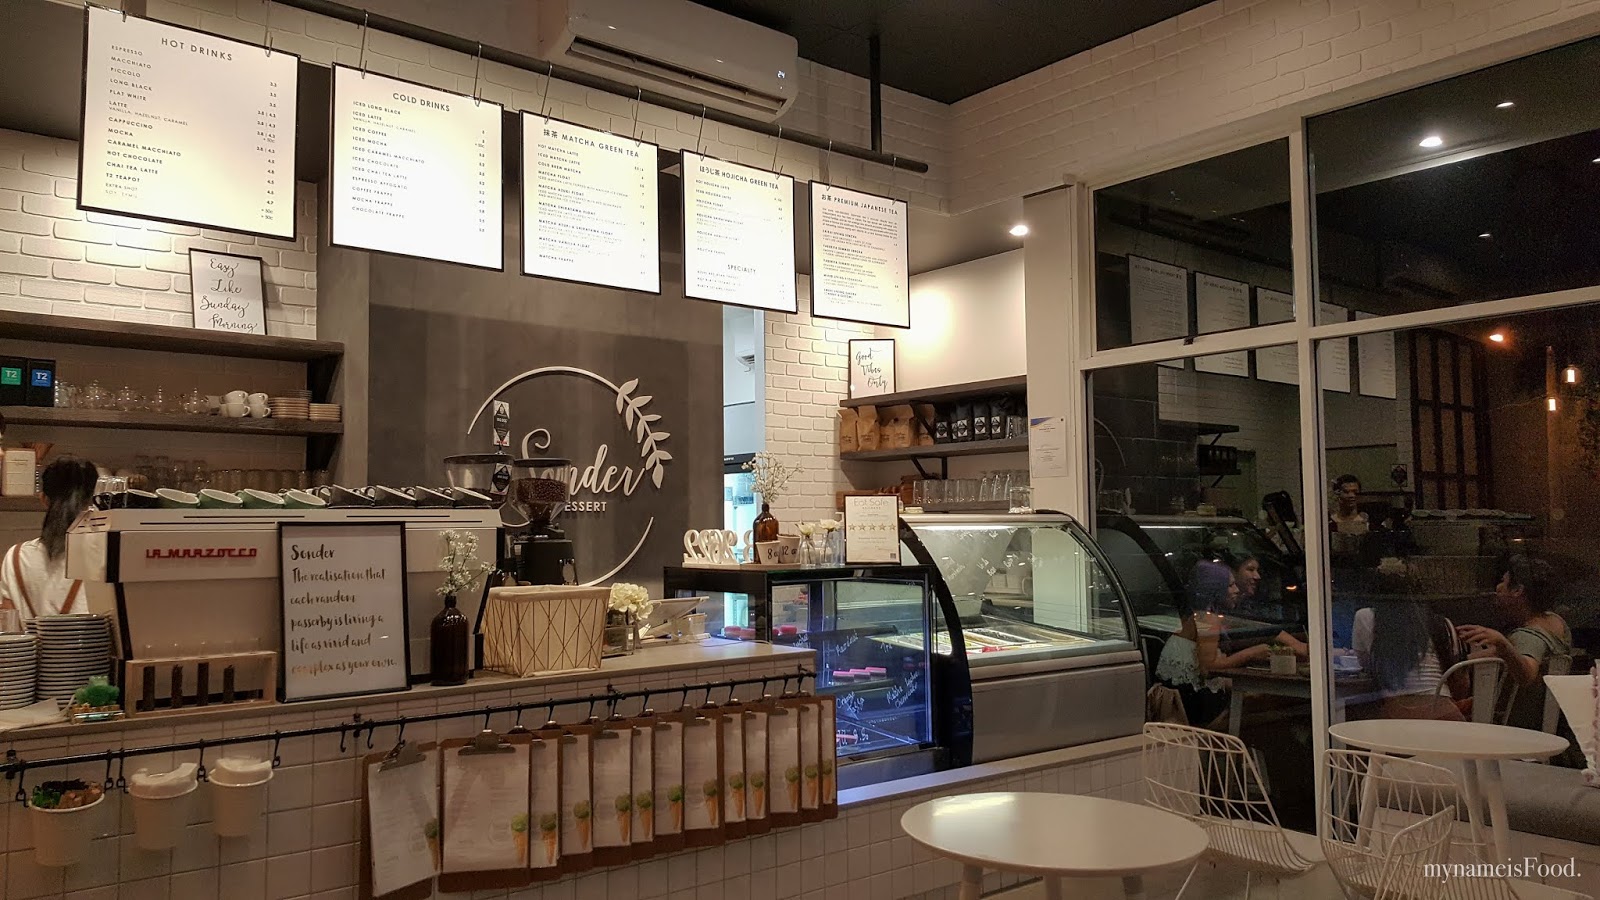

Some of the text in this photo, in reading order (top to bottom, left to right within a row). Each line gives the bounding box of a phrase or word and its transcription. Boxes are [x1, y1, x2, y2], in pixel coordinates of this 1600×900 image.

[111, 45, 143, 56] ESPRESSO
[161, 38, 233, 61] HOT DRINKS
[110, 56, 152, 69] MACCHIATO
[110, 67, 141, 78] PICCOLO
[110, 78, 153, 91] LONG BLACK
[109, 89, 147, 101] FLAT WHITE
[393, 92, 450, 112] COLD DRINKS
[384, 107, 401, 115] BLACK
[108, 117, 153, 129] CAPPUCCINO
[108, 128, 133, 137] MOCHA
[367, 129, 387, 137] COFFEE
[107, 139, 181, 157] CARAMEL MACCHIATO
[543, 128, 639, 158] 抹茶 MATCHA GREEN TEA
[367, 149, 392, 158] CARAMEL
[394, 154, 425, 164] MACCHIATO
[548, 146, 566, 154] MATCHA
[122, 153, 163, 164] CHOCOLATE
[116, 174, 140, 182] TEAPOT
[721, 171, 748, 182] HOJICHA
[749, 178, 768, 187] GREEN
[834, 197, 859, 206] PREMIUM
[861, 203, 886, 213] JAPANESE
[210, 258, 239, 278] Easy
[727, 265, 756, 273] SPECIALTY
[211, 279, 242, 293] Like
[200, 295, 249, 318] Sunday
[209, 313, 257, 334] Morning
[5, 370, 17, 378] T2
[36, 372, 48, 380] T2
[868, 376, 888, 393] Only
[854, 498, 868, 506] Eat
[291, 544, 335, 561] Sonder
[767, 548, 773, 559] 8
[782, 545, 789, 555] 12
[292, 567, 385, 584] The realisation that
[290, 590, 355, 605] each random
[291, 613, 383, 631] passerby is living a
[291, 633, 371, 654] life as vivid and
[336, 661, 346, 671] as
[348, 659, 369, 675] your
